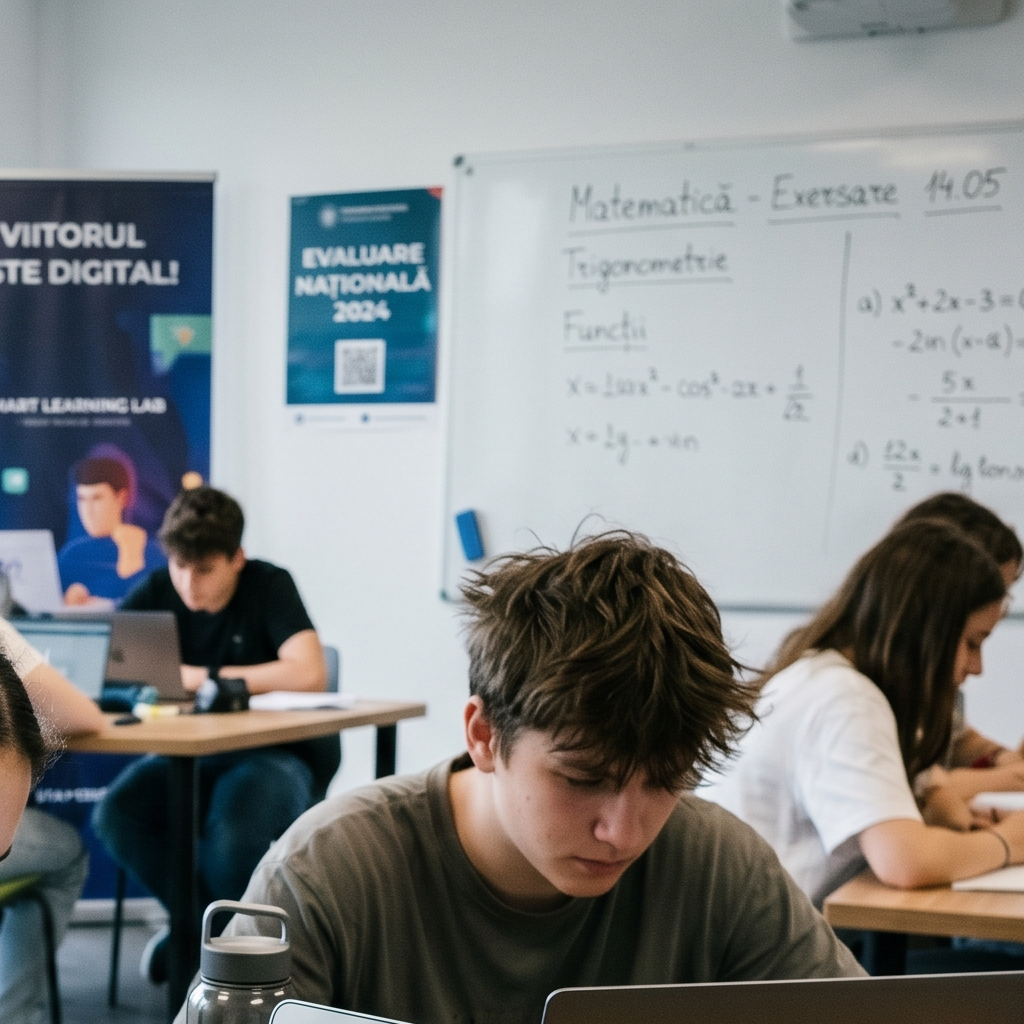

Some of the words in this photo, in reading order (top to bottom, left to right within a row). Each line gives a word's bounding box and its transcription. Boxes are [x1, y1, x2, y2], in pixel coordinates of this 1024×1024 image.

[569, 179, 735, 223] Matematică
[771, 173, 899, 211] Exersare
[923, 167, 1007, 203] 14.05
[302, 242, 426, 269] EVALUARE
[562, 243, 728, 294] Trigonometrie
[48, 258, 180, 286] DIGITAL!
[294, 265, 432, 300] NAȚIONALĂ
[332, 300, 391, 323] 2024
[41, 397, 129, 414] LEARNING
[131, 397, 167, 414] LAB
